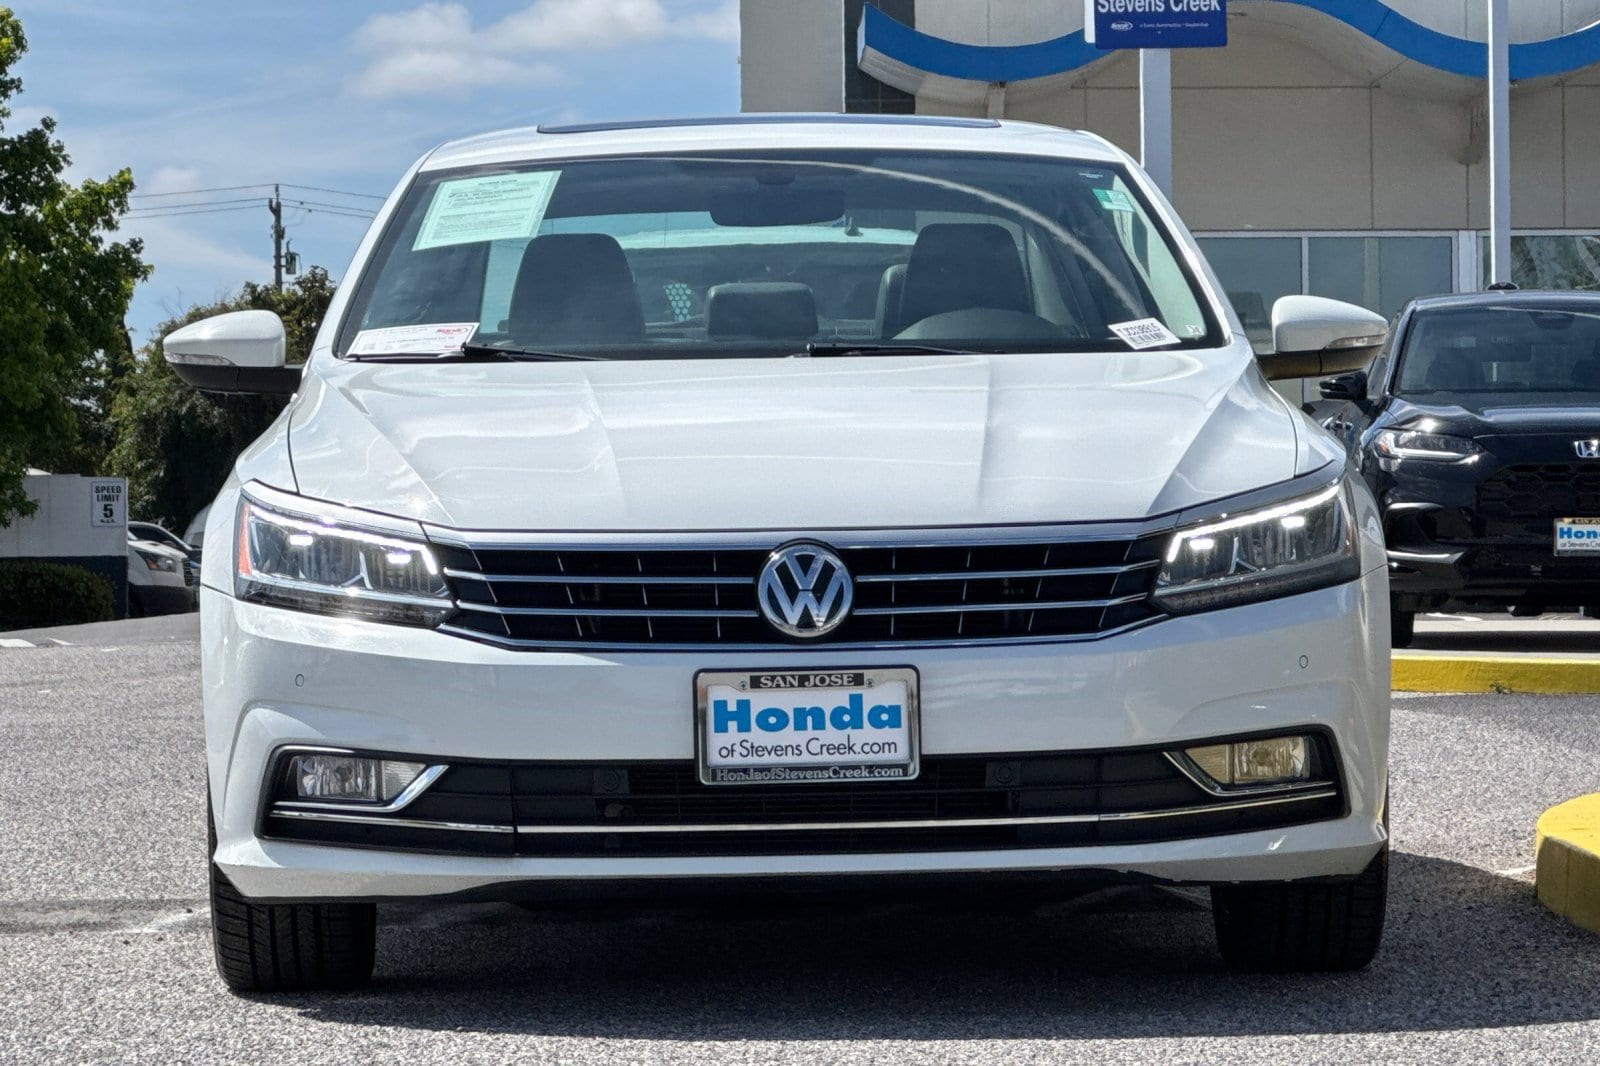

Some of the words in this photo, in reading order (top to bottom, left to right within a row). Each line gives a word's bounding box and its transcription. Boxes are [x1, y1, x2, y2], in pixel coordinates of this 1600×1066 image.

[1097, 0, 1165, 12] Stevens
[1169, 0, 1221, 12] Creek
[95, 485, 121, 493] SPEED
[96, 494, 119, 502] LIMIT
[103, 503, 114, 518] 5
[1559, 526, 1600, 539] Hon
[759, 675, 800, 688] SAN
[804, 674, 855, 687] JOSE
[713, 693, 902, 733] Honda
[718, 742, 737, 758] of
[739, 739, 803, 757] Stevens
[805, 734, 898, 755] Creek.com
[715, 766, 904, 782] HondaofStevensCreek.com
